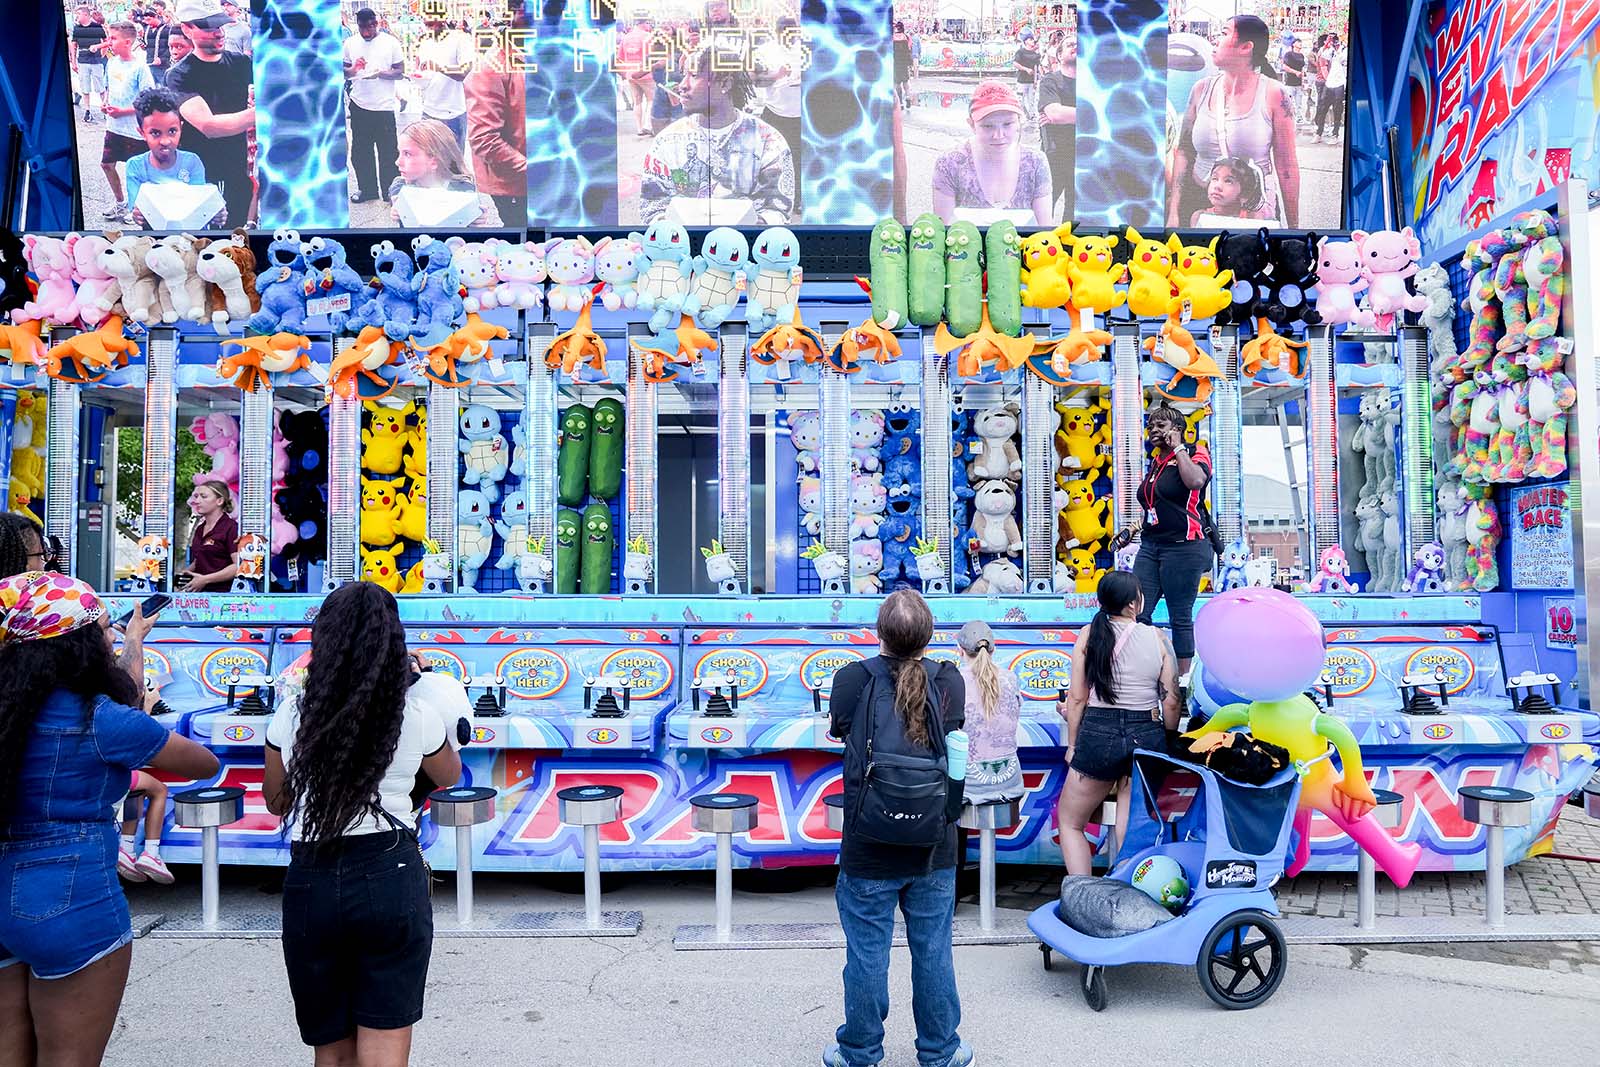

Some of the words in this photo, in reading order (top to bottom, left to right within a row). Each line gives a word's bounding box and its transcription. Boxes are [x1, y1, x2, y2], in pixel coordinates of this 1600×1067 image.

[1436, 0, 1497, 76] WI
[574, 28, 812, 73] PLAYERS
[1518, 488, 1568, 513] WATER
[1523, 508, 1562, 529] RACE
[175, 598, 209, 609] PLAYERS
[1079, 597, 1101, 609] PLAY
[1549, 606, 1572, 631] 10
[726, 632, 734, 641] 9
[831, 632, 845, 641] 10
[934, 633, 947, 641] 11
[1042, 633, 1056, 642] 12
[1344, 631, 1355, 640] 15
[1444, 631, 1457, 640] 16
[216, 656, 255, 667] SHOOT
[512, 657, 553, 668] SHOOT
[616, 657, 657, 668] SHOOT
[711, 657, 751, 668] SHOOT
[1024, 657, 1065, 668] SHOOT
[1324, 656, 1360, 666] SHOOT
[1421, 655, 1459, 665] SHOOT
[516, 678, 550, 688] HERE
[630, 678, 653, 688] ERE
[1028, 678, 1061, 688] HERE
[234, 727, 244, 740] 5
[597, 729, 608, 741] 8
[711, 728, 721, 742] 9
[1432, 725, 1445, 737] 15
[1550, 725, 1564, 737] 16
[966, 762, 990, 785] HILLS
